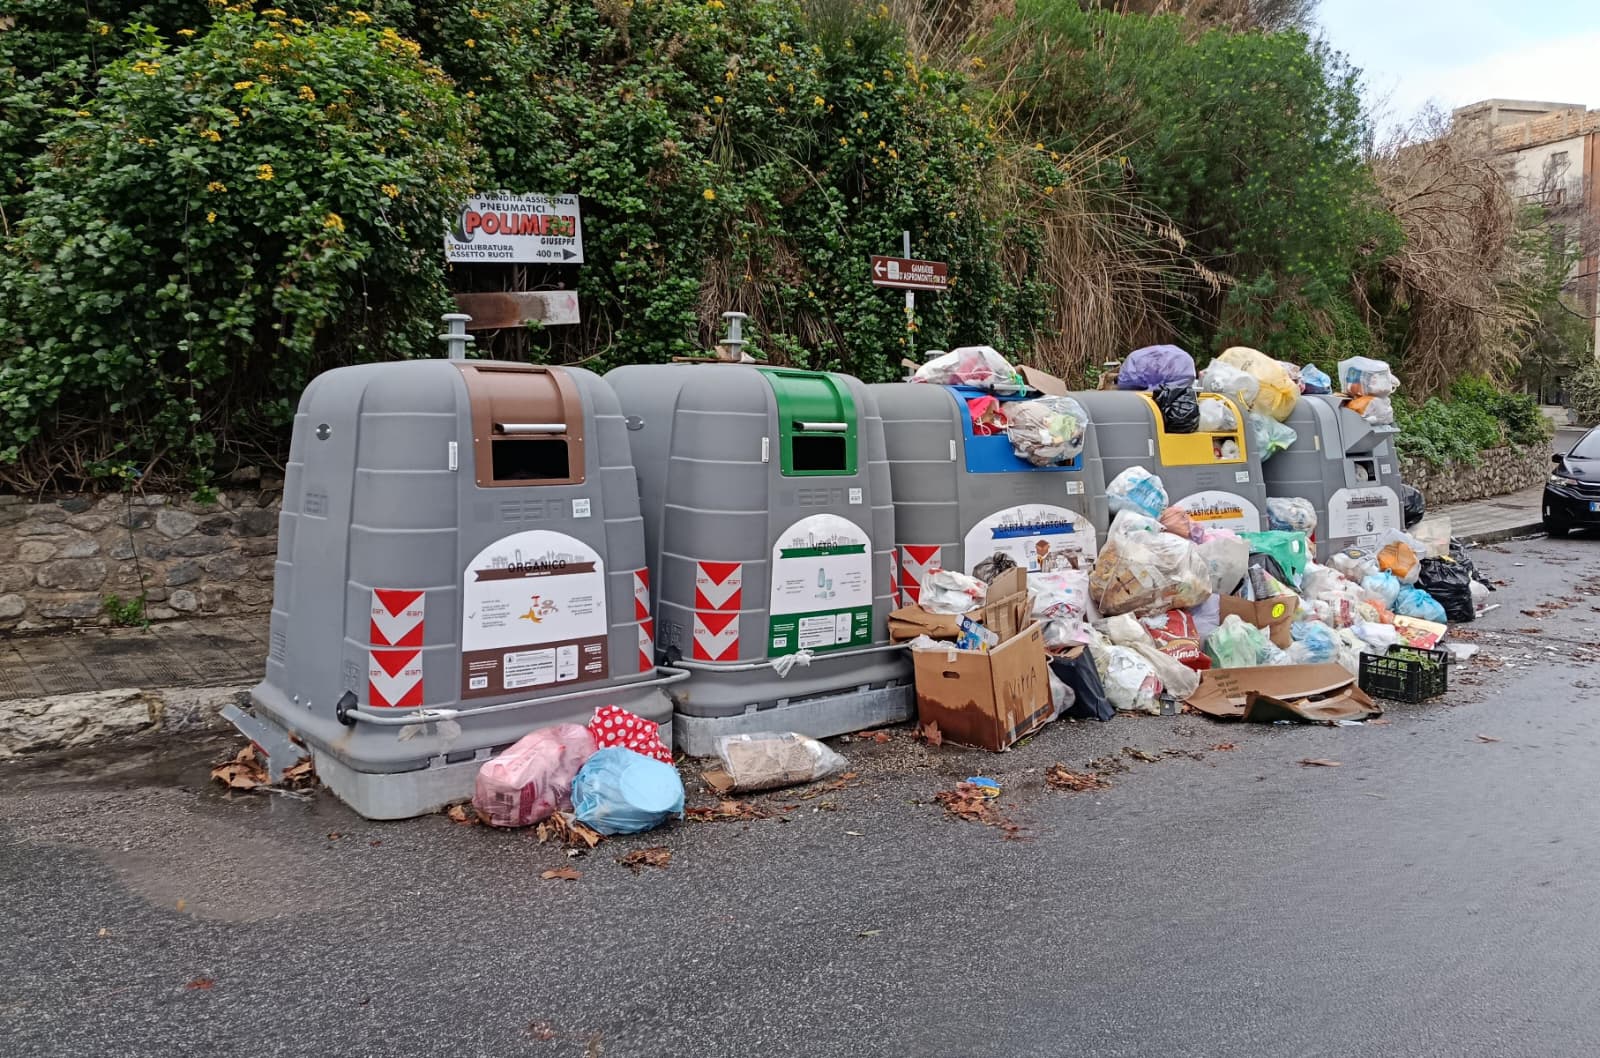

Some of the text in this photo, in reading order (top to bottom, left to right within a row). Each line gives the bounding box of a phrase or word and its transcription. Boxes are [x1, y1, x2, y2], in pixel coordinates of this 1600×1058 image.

[485, 194, 523, 202] VENDITA
[480, 203, 545, 213] PNEUMATICI
[541, 237, 575, 246] GIUSEPPE
[536, 250, 551, 258] 400
[998, 523, 1024, 532] CARTA
[1036, 519, 1068, 529] CARTONE
[811, 542, 838, 551] VETRO
[508, 559, 566, 572] ORGANICO
